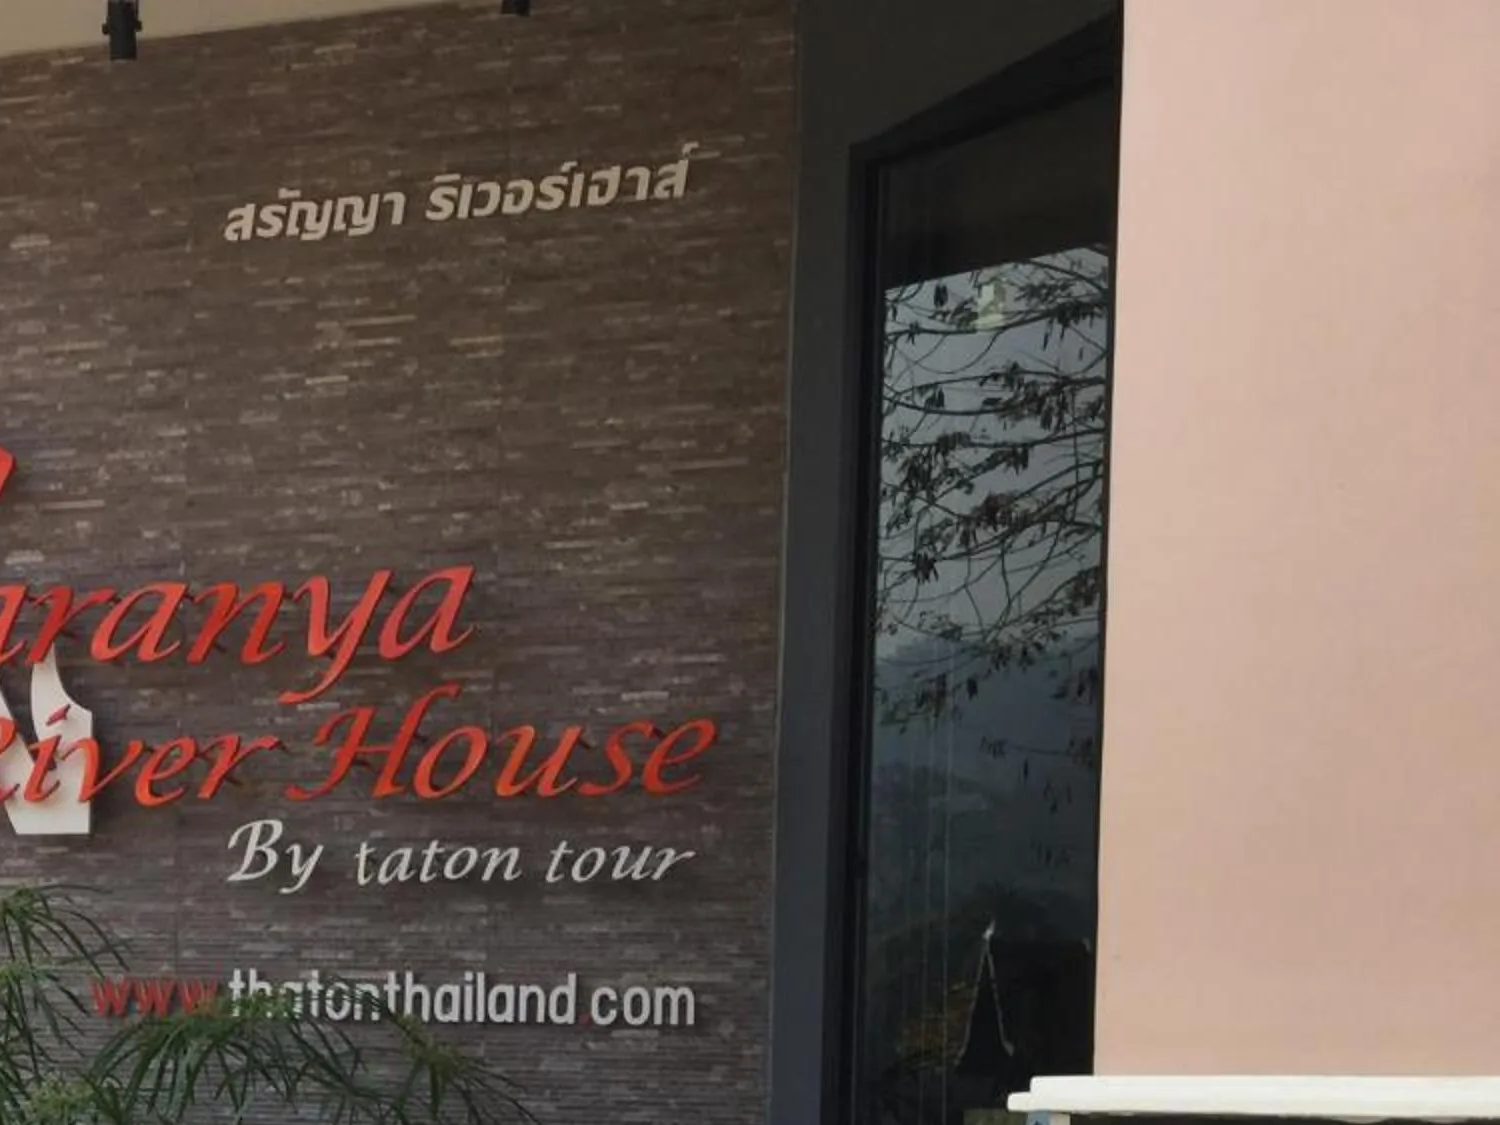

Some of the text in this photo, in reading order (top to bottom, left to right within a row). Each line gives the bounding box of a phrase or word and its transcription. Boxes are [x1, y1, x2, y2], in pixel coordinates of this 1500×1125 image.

[223, 141, 699, 242] สรัญญา ริเวอร์เฮาส์
[288, 682, 719, 800] House
[227, 818, 697, 895] By taton tour
